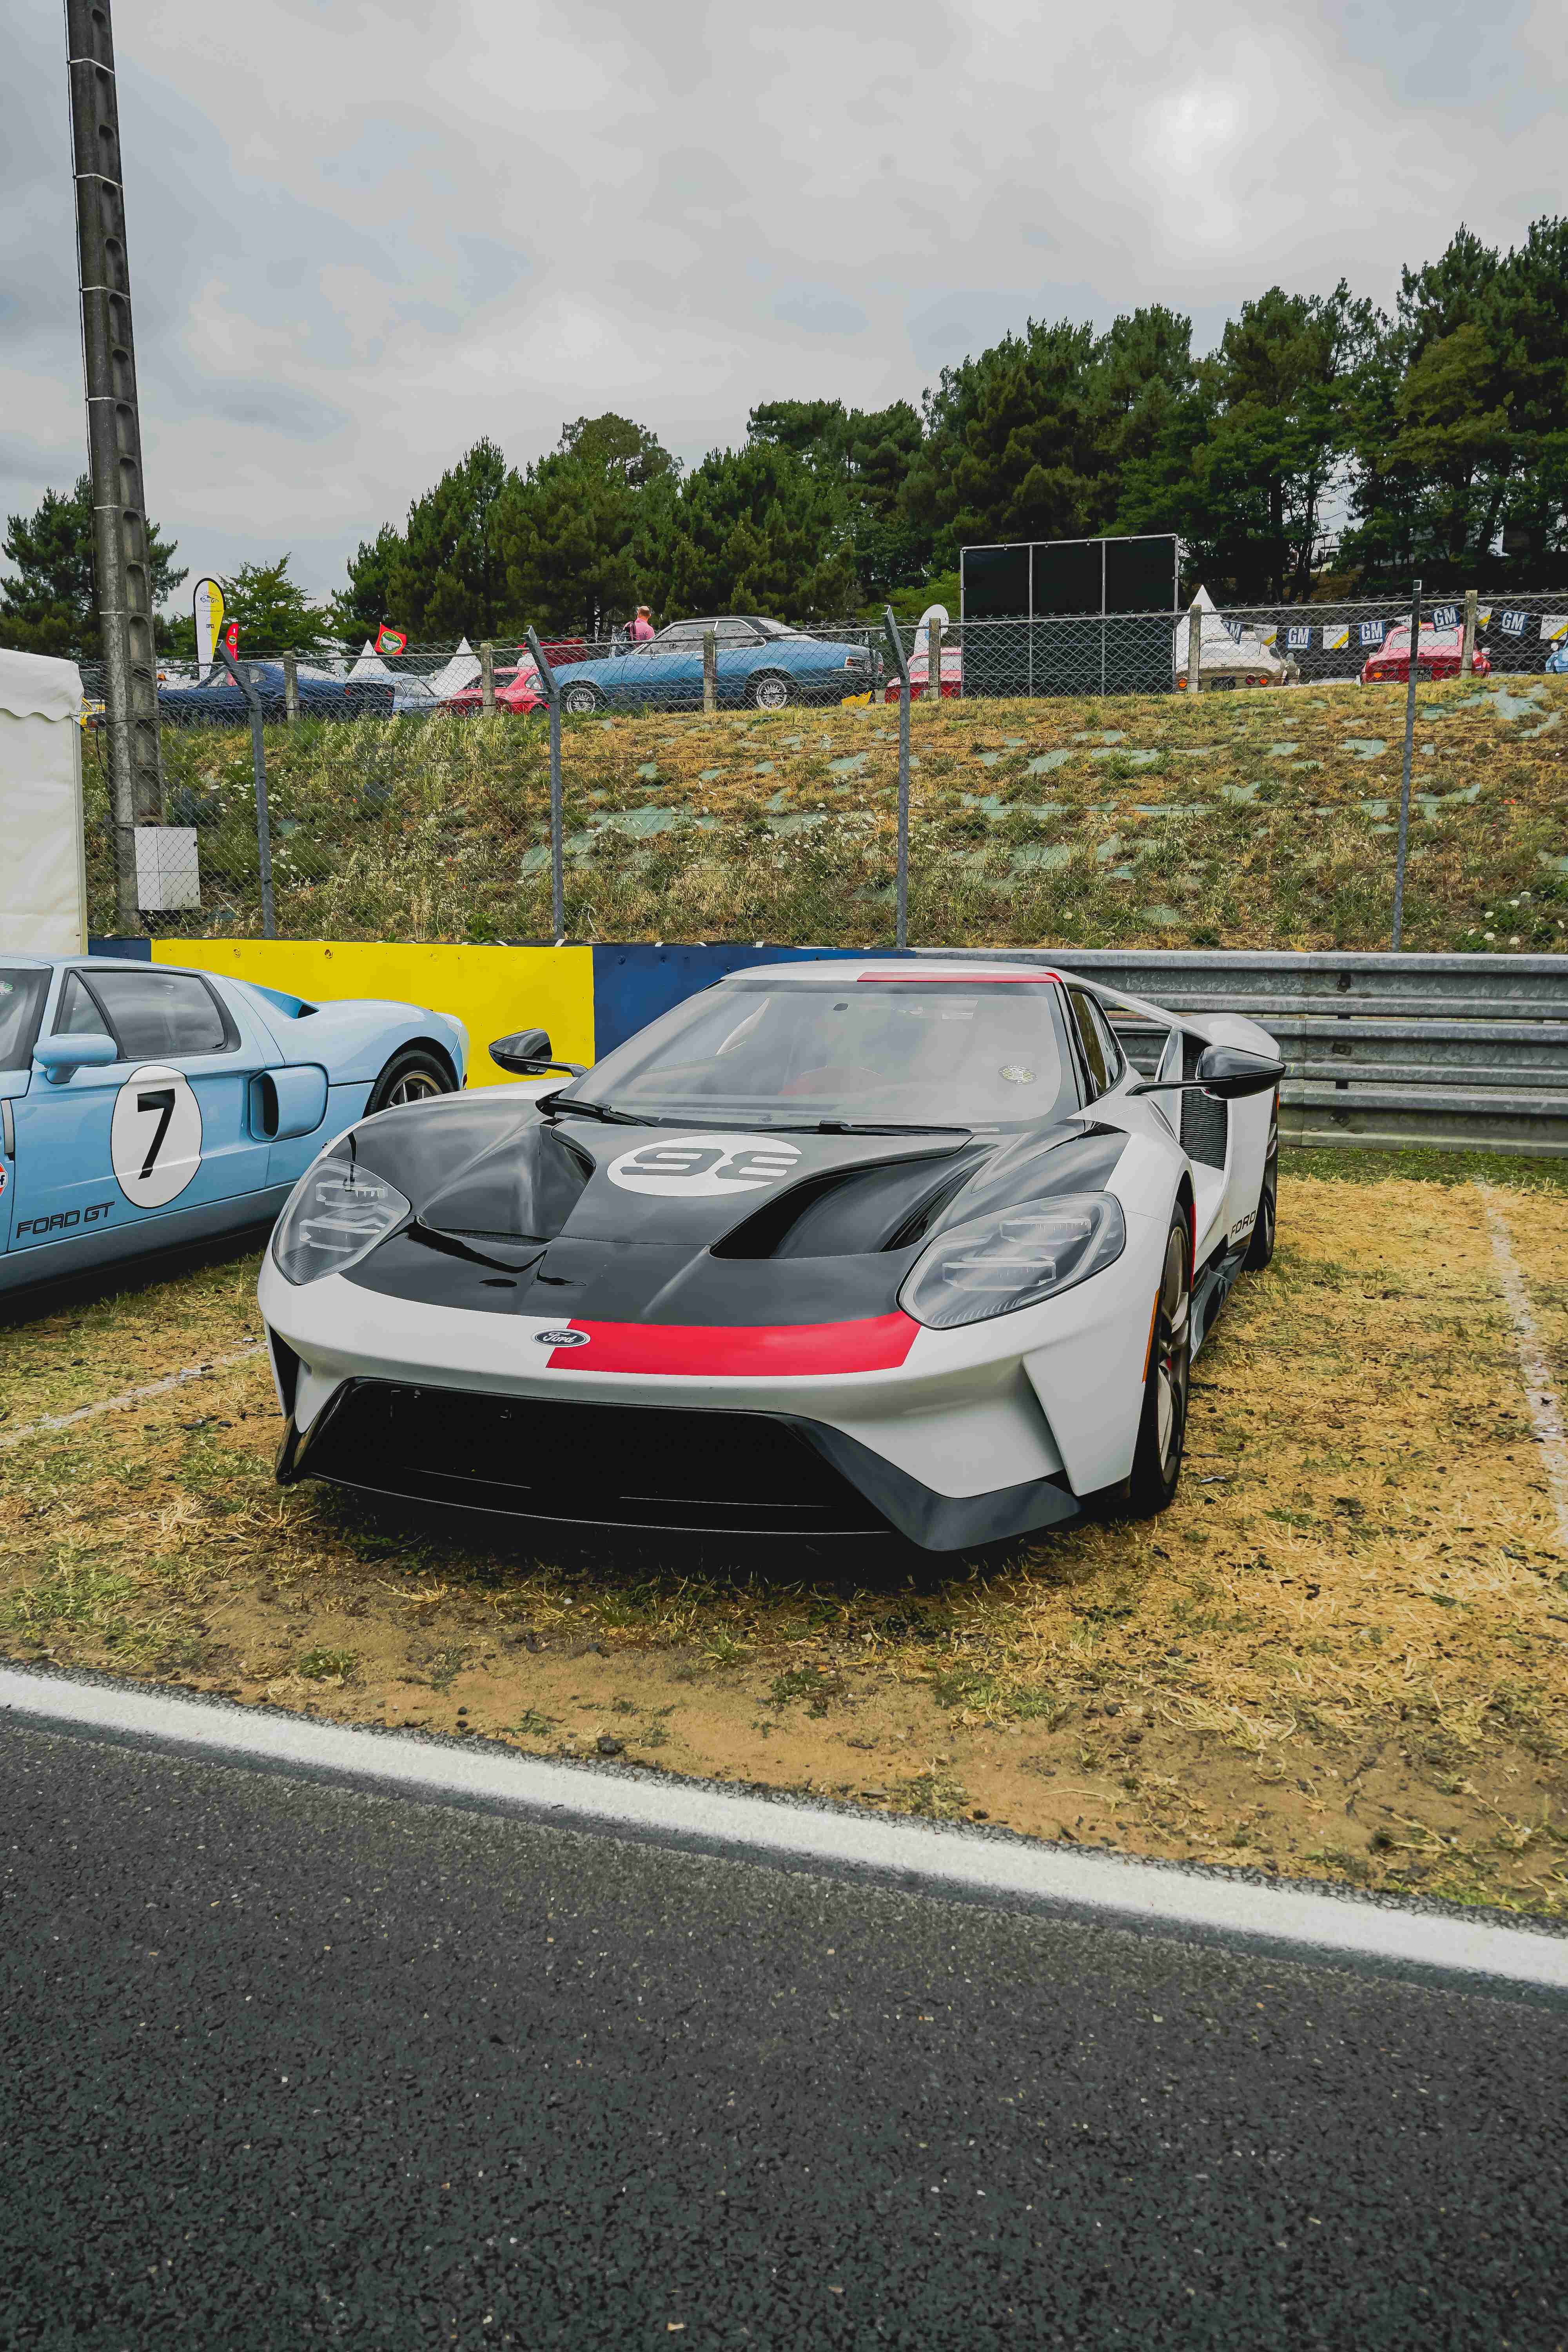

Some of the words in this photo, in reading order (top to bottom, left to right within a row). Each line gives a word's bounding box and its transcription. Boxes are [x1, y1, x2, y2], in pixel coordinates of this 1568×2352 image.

[1434, 608, 1457, 626] GM
[1502, 612, 1525, 631] GM
[1288, 628, 1309, 644] GM
[1361, 622, 1383, 640] GM
[137, 1088, 176, 1180] 7
[619, 1147, 803, 1183] 98
[16, 1210, 80, 1239] FORD
[84, 1201, 115, 1222] GT
[1230, 1209, 1257, 1239] FORD
[543, 1332, 577, 1343] Ford
